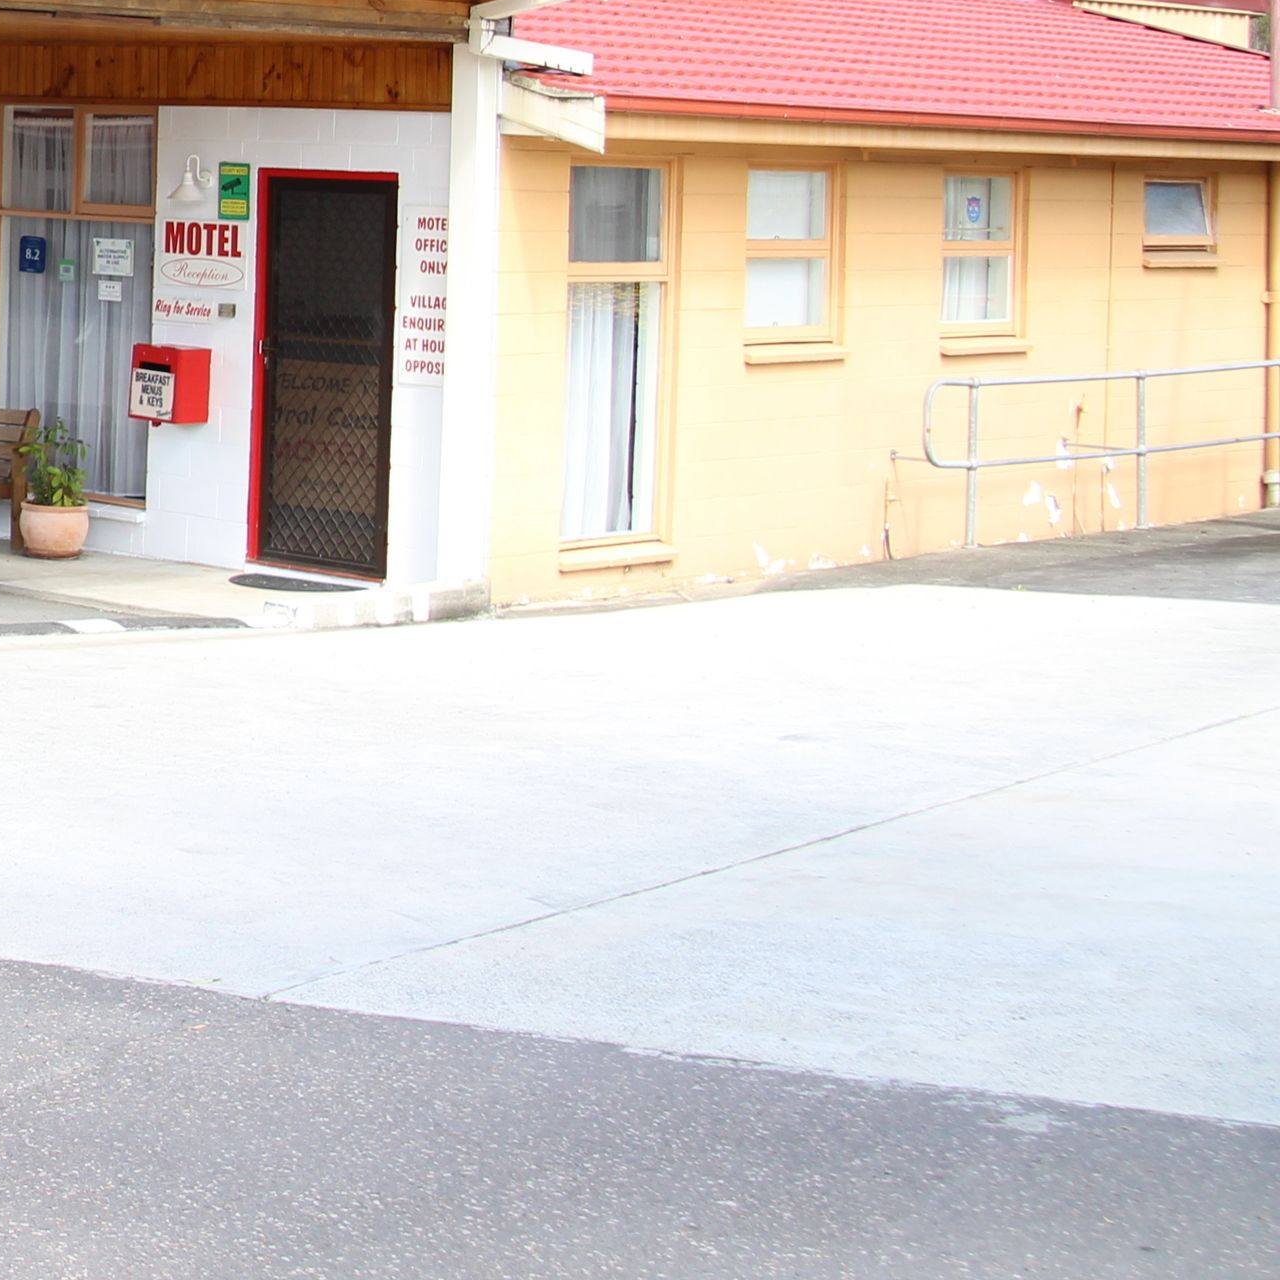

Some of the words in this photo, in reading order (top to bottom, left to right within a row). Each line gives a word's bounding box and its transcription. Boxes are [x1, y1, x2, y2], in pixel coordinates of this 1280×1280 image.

[164, 220, 242, 258] MOTEL
[25, 248, 40, 261] 8.2
[172, 262, 229, 286] Reception
[420, 260, 447, 274] ONLY
[155, 299, 171, 317] Ring
[173, 300, 184, 314] for
[185, 302, 211, 317] Service
[405, 338, 418, 351] AT
[135, 371, 171, 386] BREAKFAST
[142, 383, 163, 396] MENUS
[147, 396, 163, 408] KEYS
